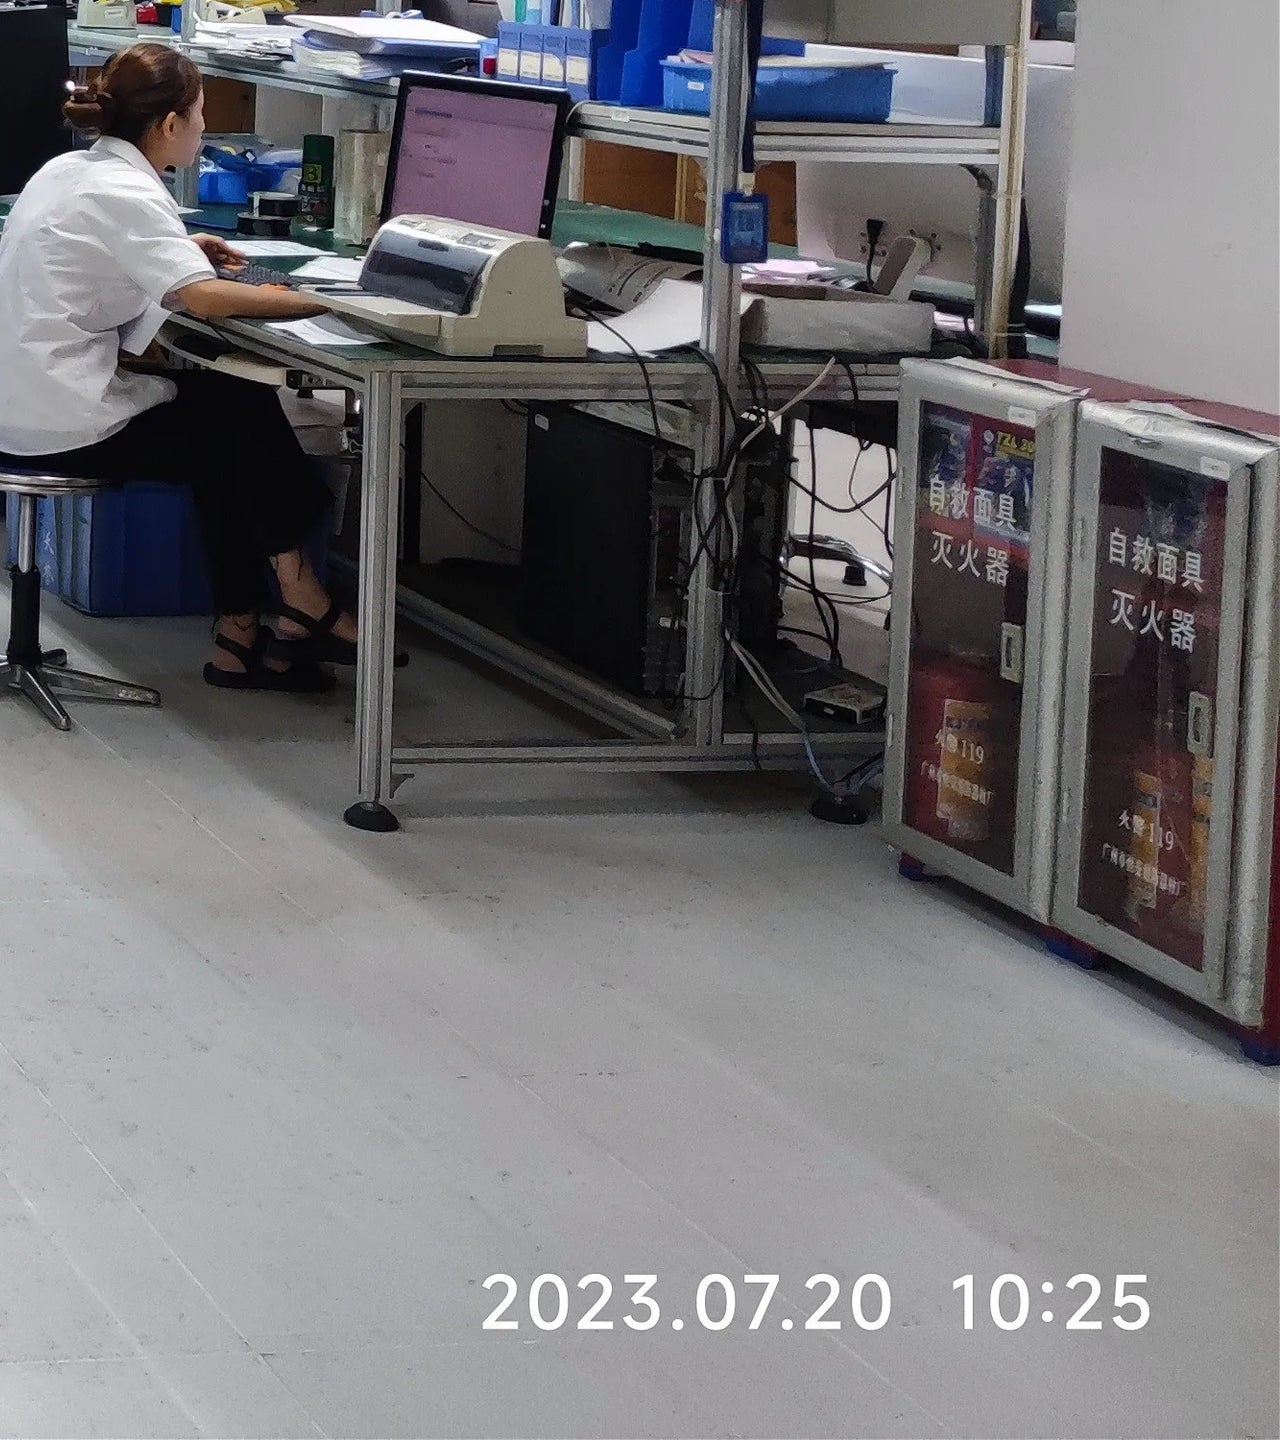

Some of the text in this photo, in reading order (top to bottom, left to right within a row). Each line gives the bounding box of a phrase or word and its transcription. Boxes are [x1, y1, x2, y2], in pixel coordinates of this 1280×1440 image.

[929, 476, 1017, 531] 自救面具
[930, 530, 1010, 587] 灭火器
[1107, 527, 1206, 593] 自救面具
[1110, 588, 1197, 654] 灭火器
[961, 738, 985, 765] 119
[1149, 822, 1175, 851] 119
